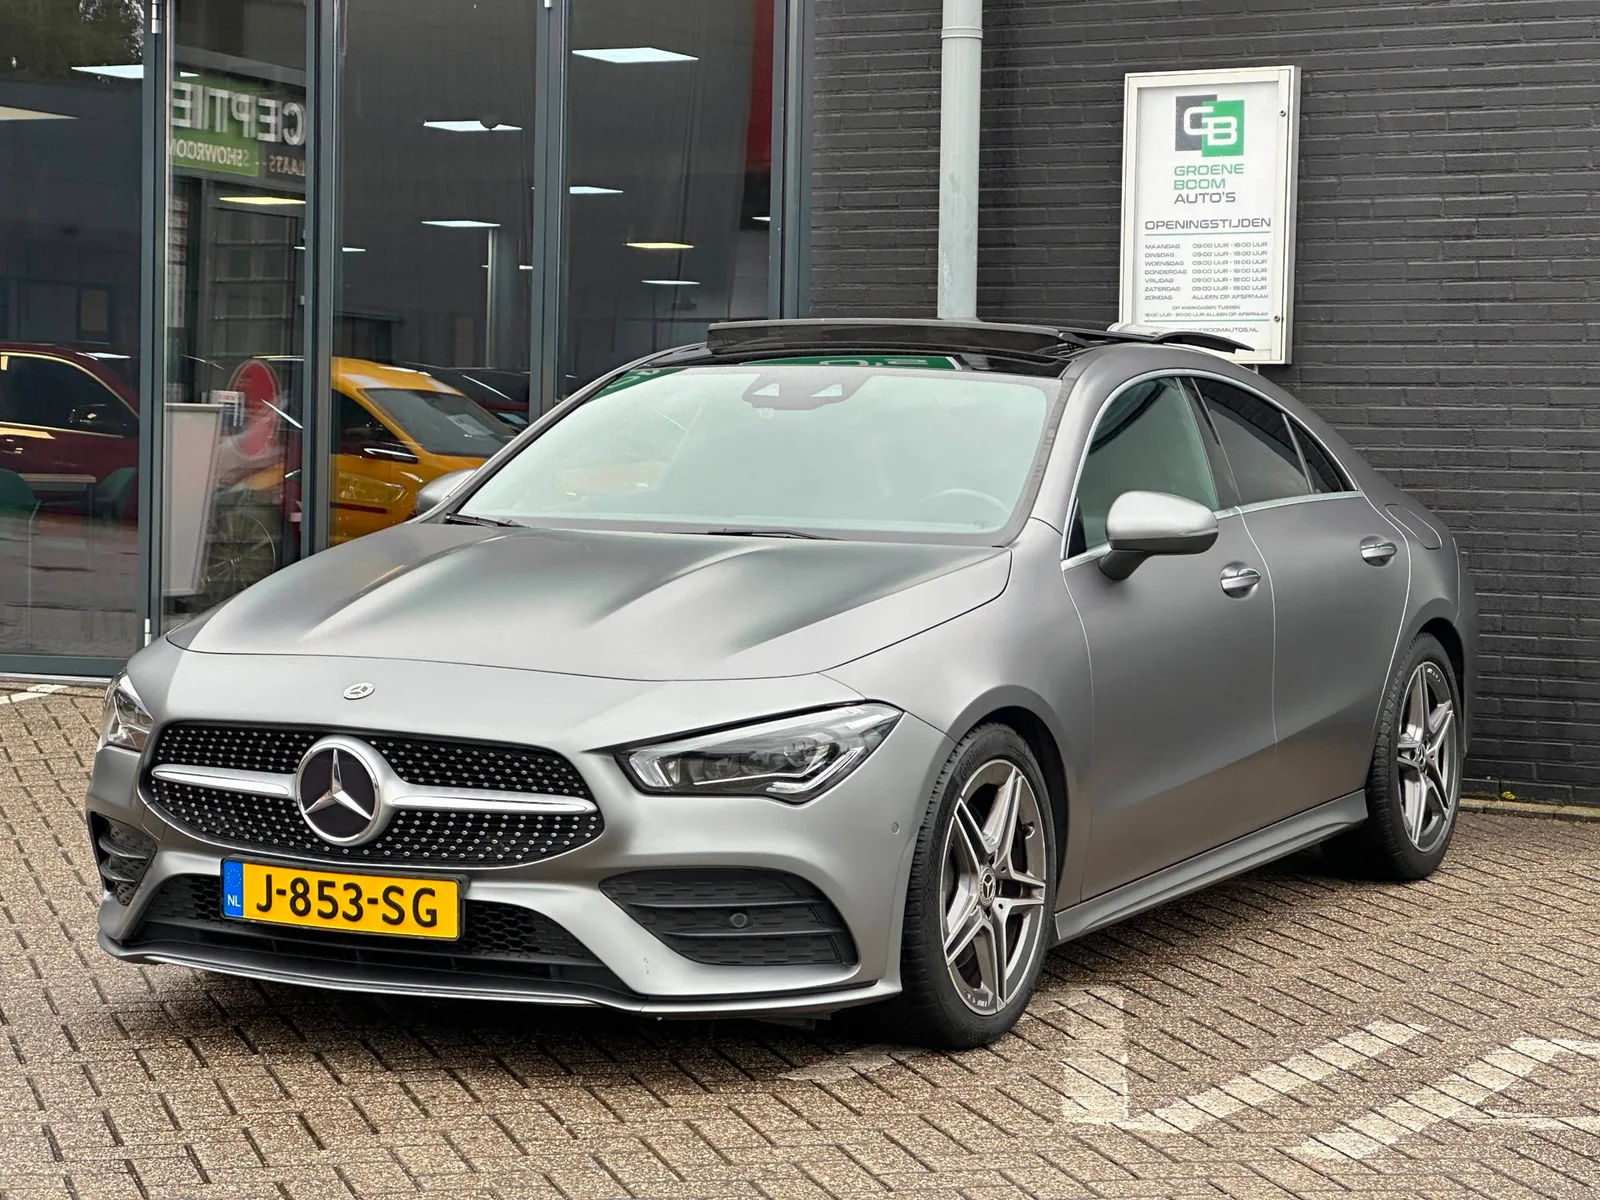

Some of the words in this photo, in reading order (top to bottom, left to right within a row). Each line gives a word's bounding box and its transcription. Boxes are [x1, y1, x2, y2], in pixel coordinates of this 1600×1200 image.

[1174, 163, 1244, 177] GROENE
[1174, 178, 1226, 190] BOOM
[1174, 191, 1236, 204] AUTO'S
[1144, 217, 1271, 230] OPENINGSTIJDEN
[227, 895, 241, 908] NL
[256, 874, 438, 928] J-853-SG
